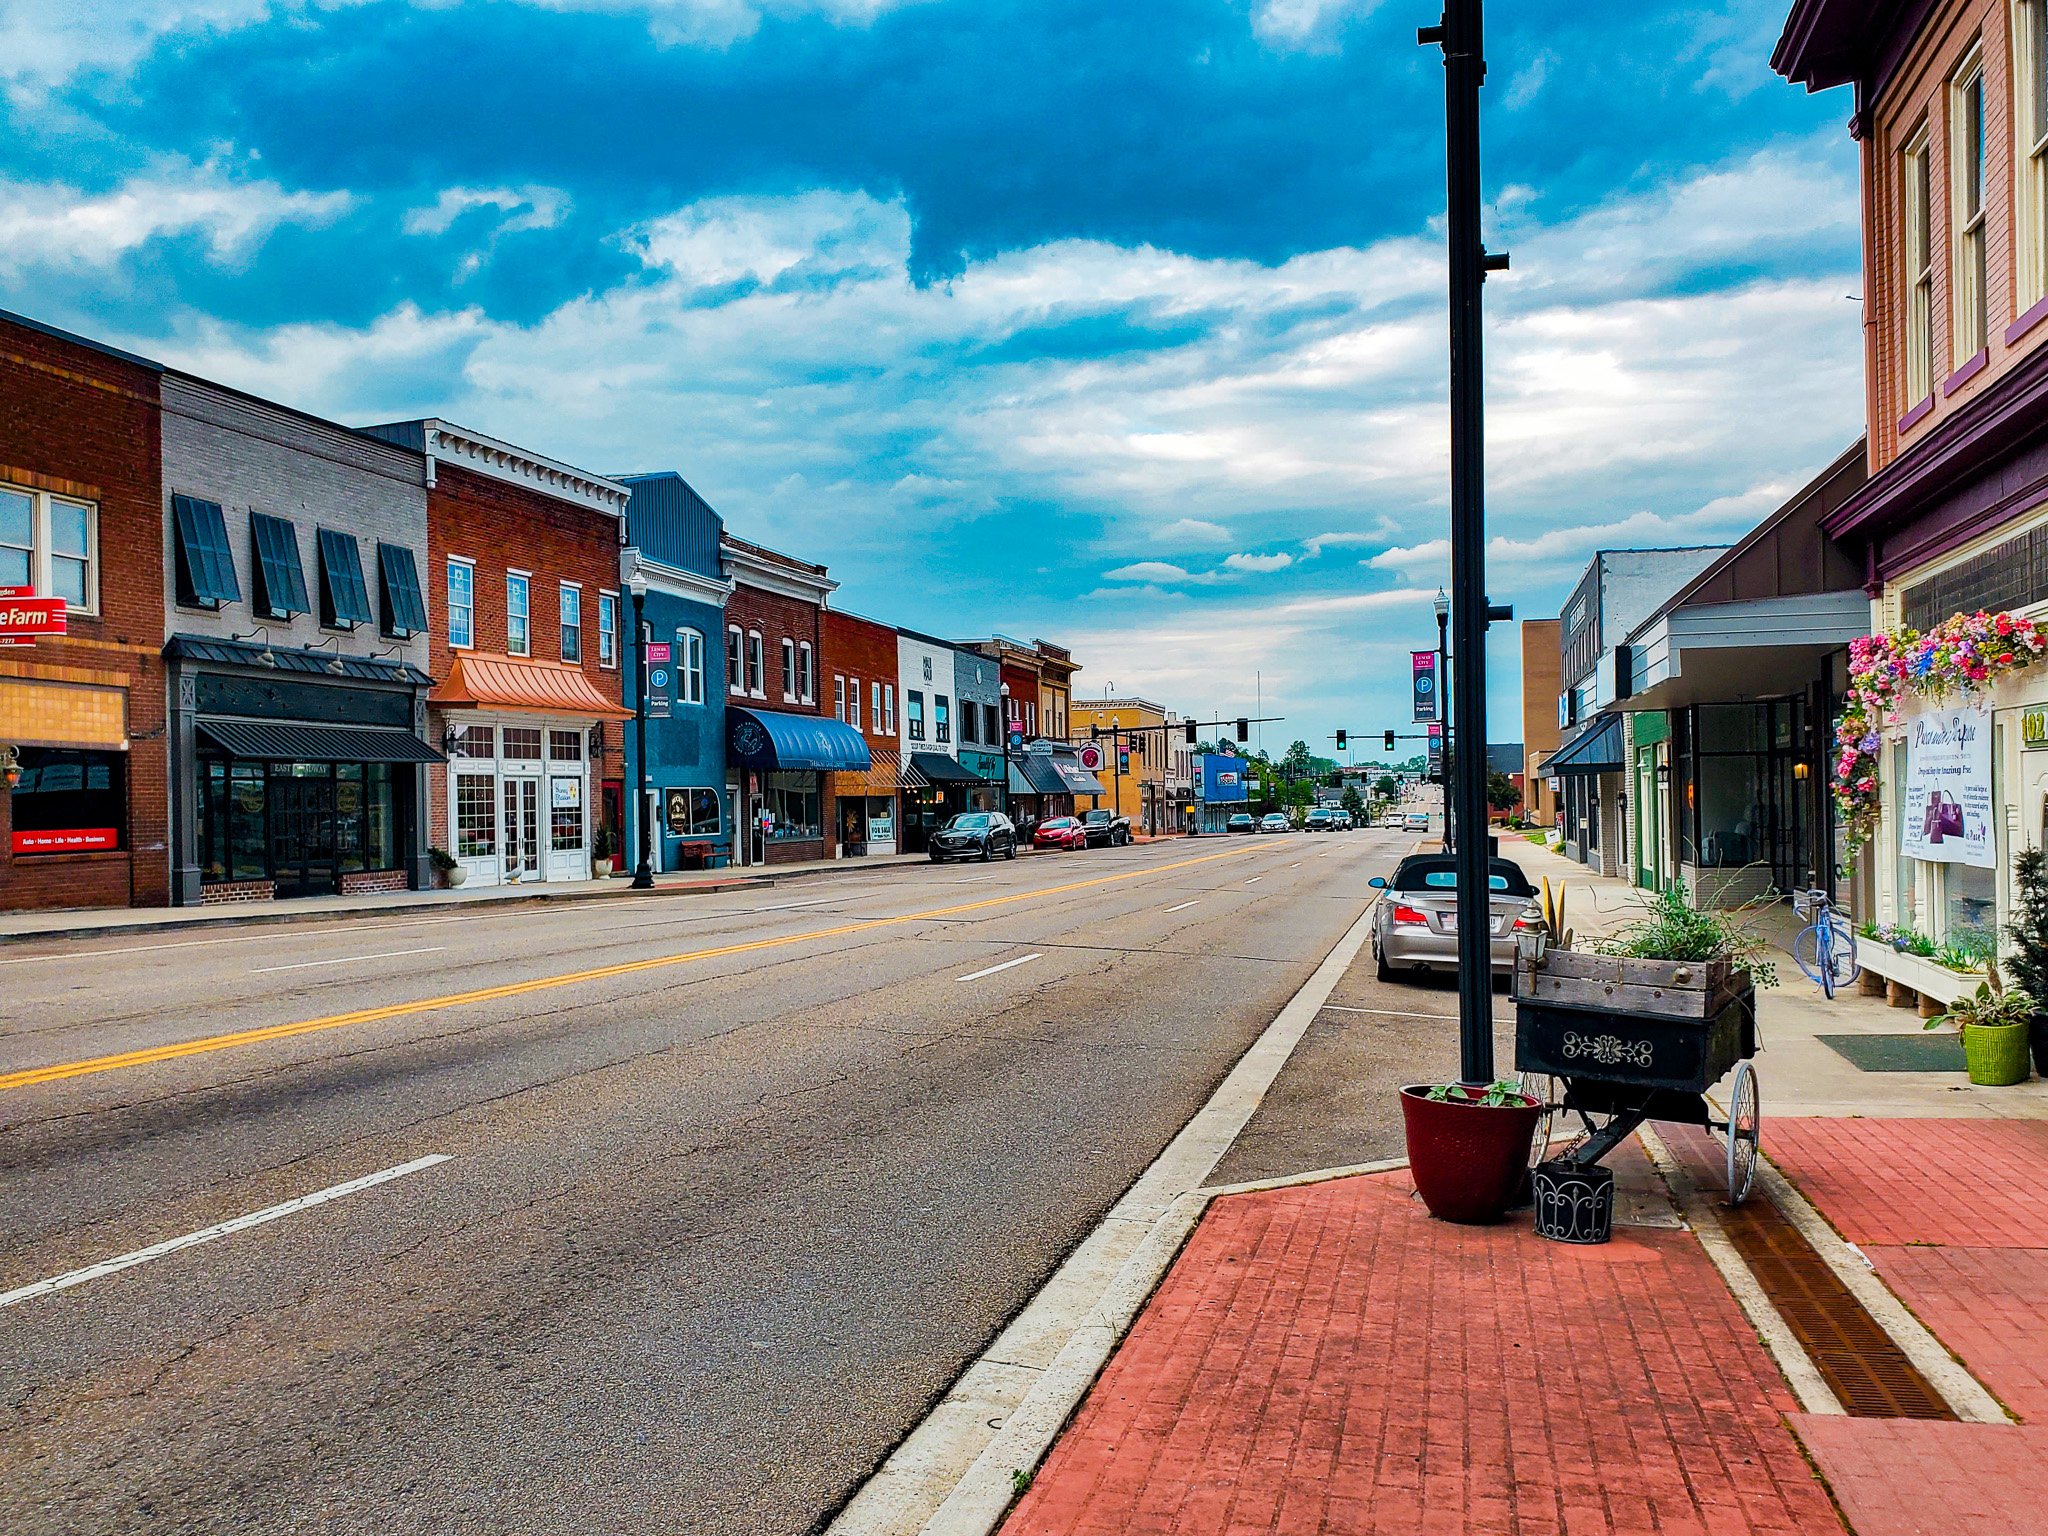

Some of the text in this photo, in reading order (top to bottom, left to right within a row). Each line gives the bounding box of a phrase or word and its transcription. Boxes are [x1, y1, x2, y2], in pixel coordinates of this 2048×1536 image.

[2021, 711, 2046, 741] 102
[274, 763, 292, 772] EAST
[871, 826, 891, 834] FOR SALE
